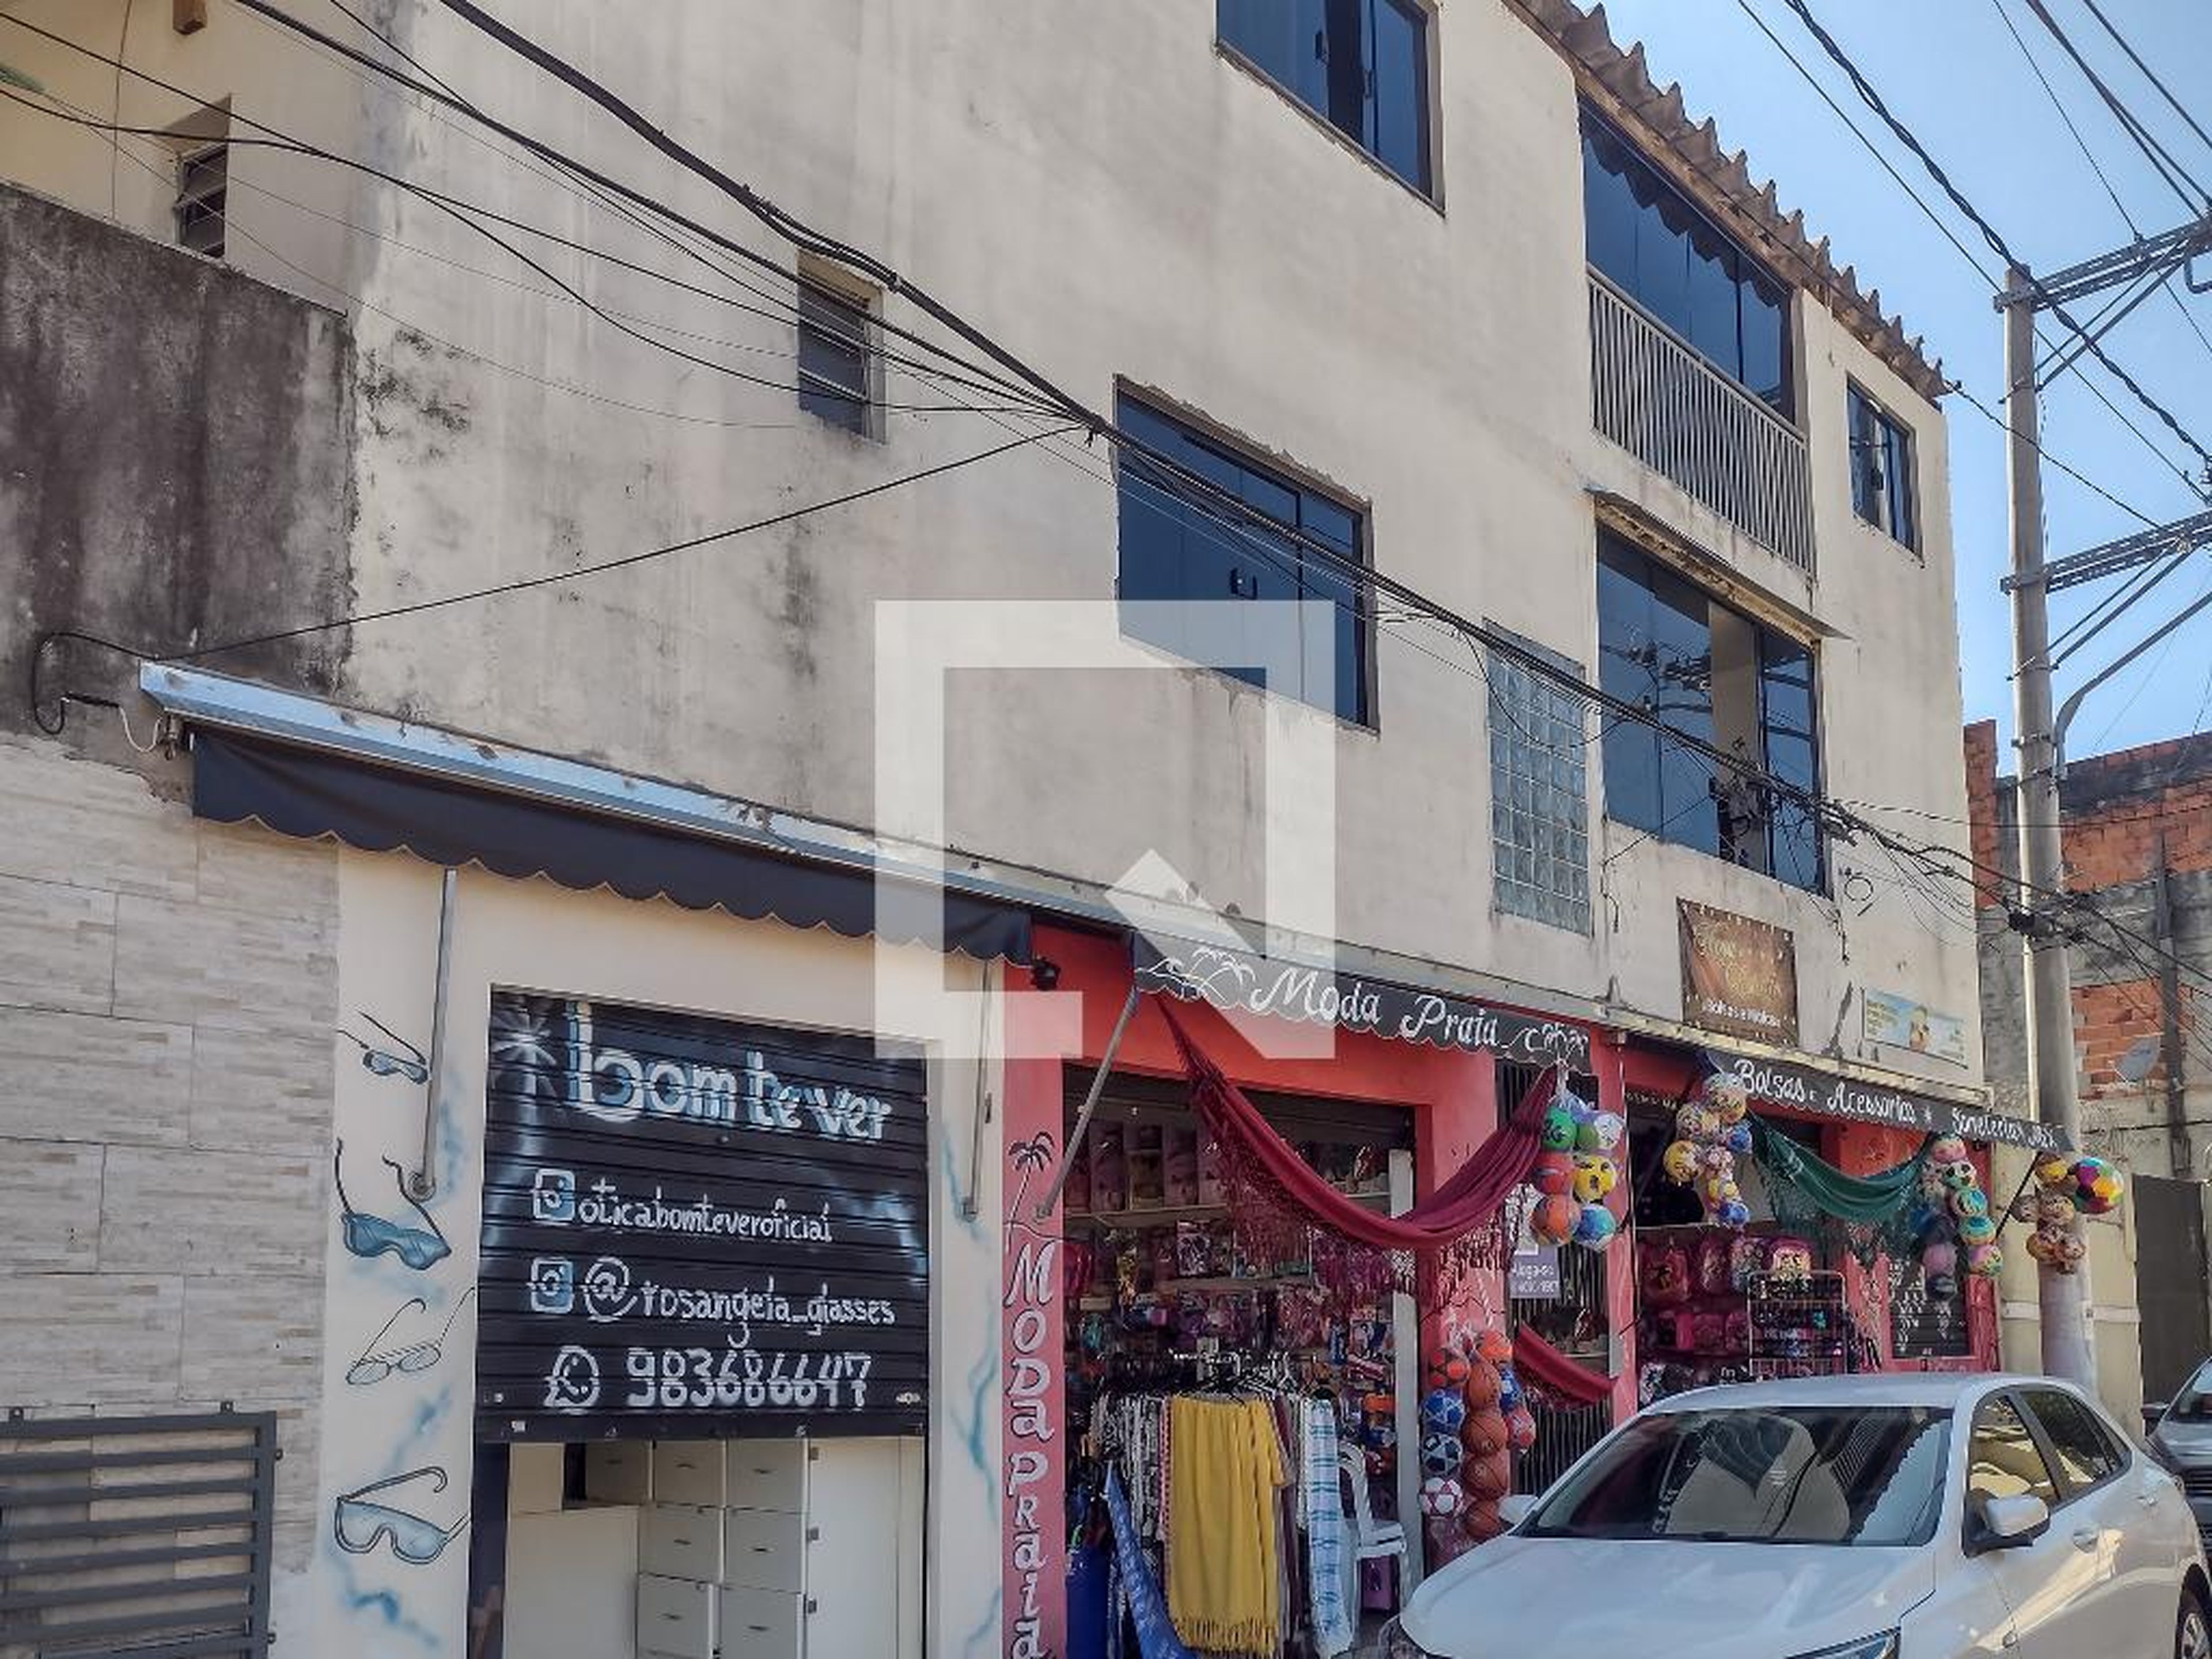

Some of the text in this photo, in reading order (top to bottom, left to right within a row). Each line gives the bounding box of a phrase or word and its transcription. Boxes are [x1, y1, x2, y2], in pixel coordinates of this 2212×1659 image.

[1252, 967, 1499, 1047] Moda Praia
[566, 1001, 737, 1124] bom
[1734, 1059, 1806, 1103] Bolsas
[627, 1347, 872, 1411] 983686647
